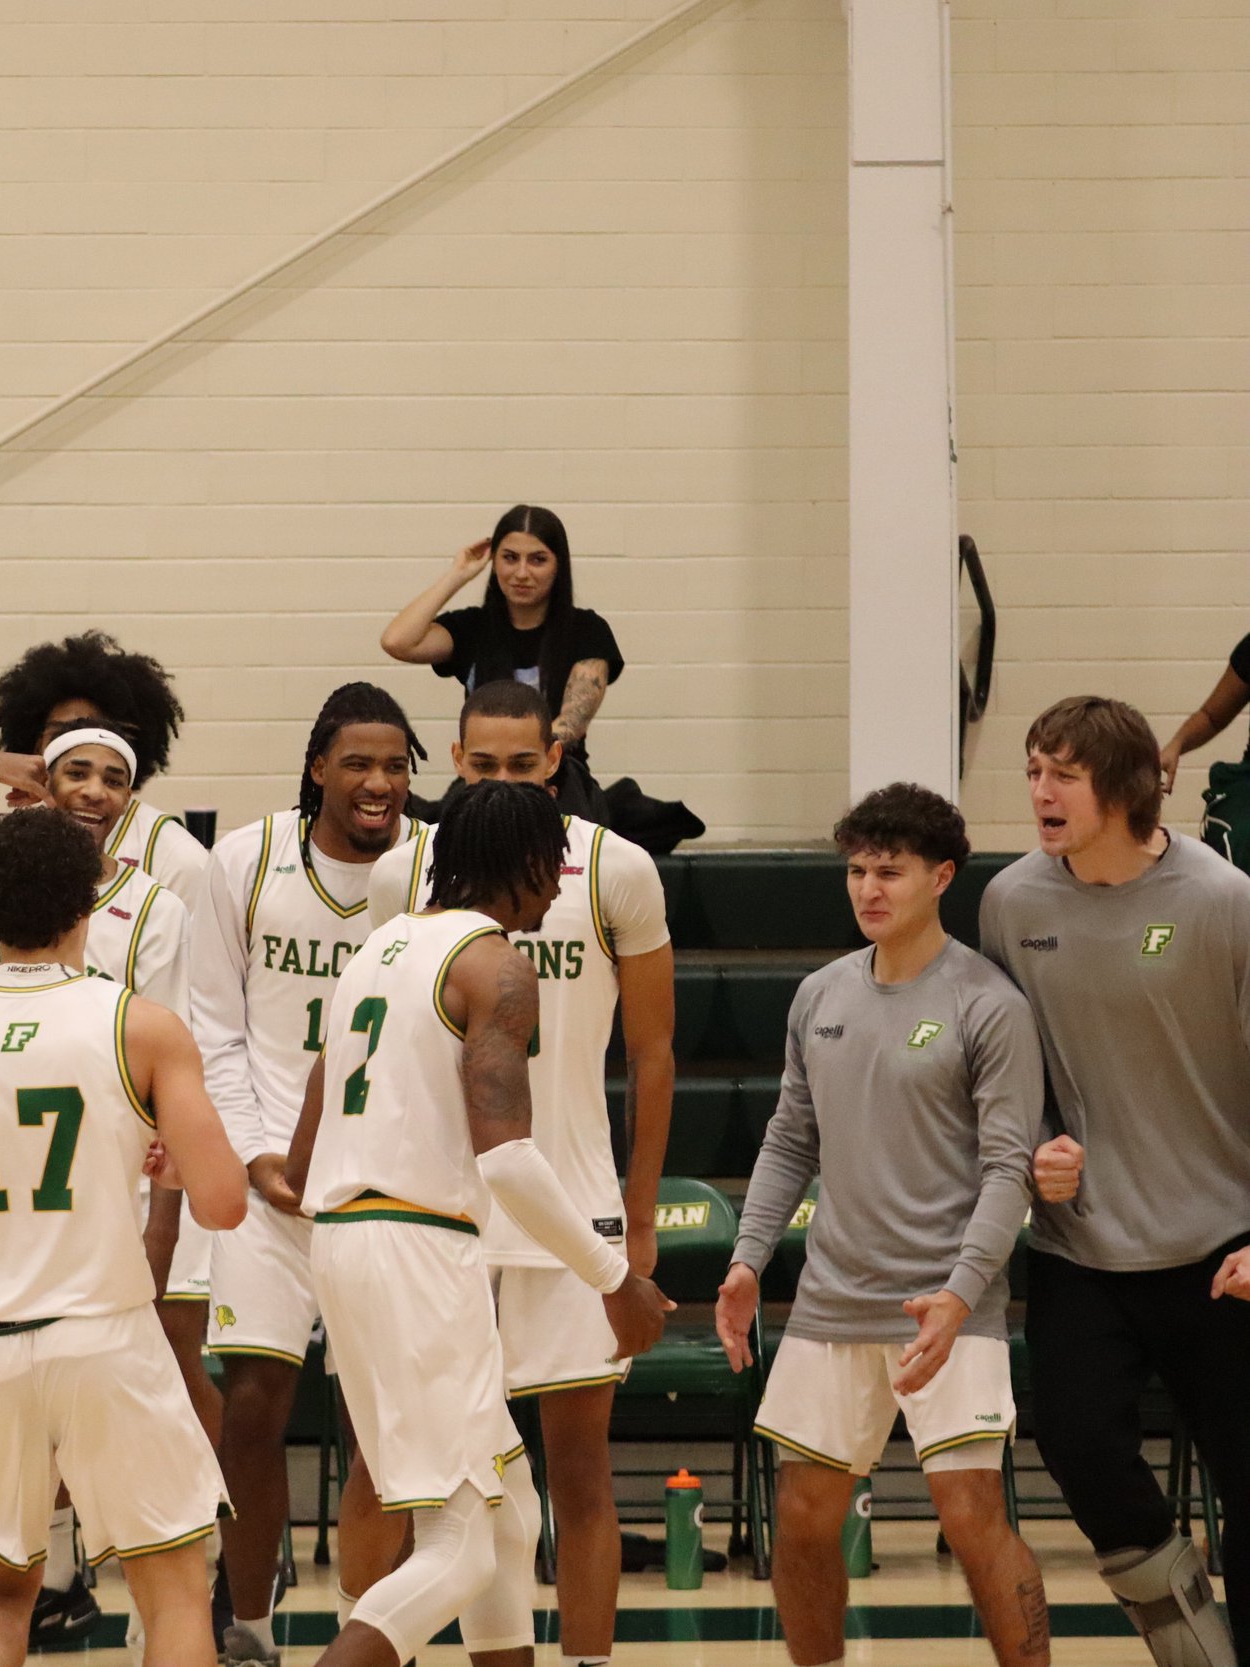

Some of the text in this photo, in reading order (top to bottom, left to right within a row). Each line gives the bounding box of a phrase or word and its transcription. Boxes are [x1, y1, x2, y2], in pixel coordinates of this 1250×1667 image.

[1020, 936, 1058, 951] capelli
[1141, 924, 1177, 956] F
[262, 935, 364, 978] FALC
[0, 1022, 40, 1052] F
[907, 1018, 945, 1049] F
[343, 997, 388, 1115] 2
